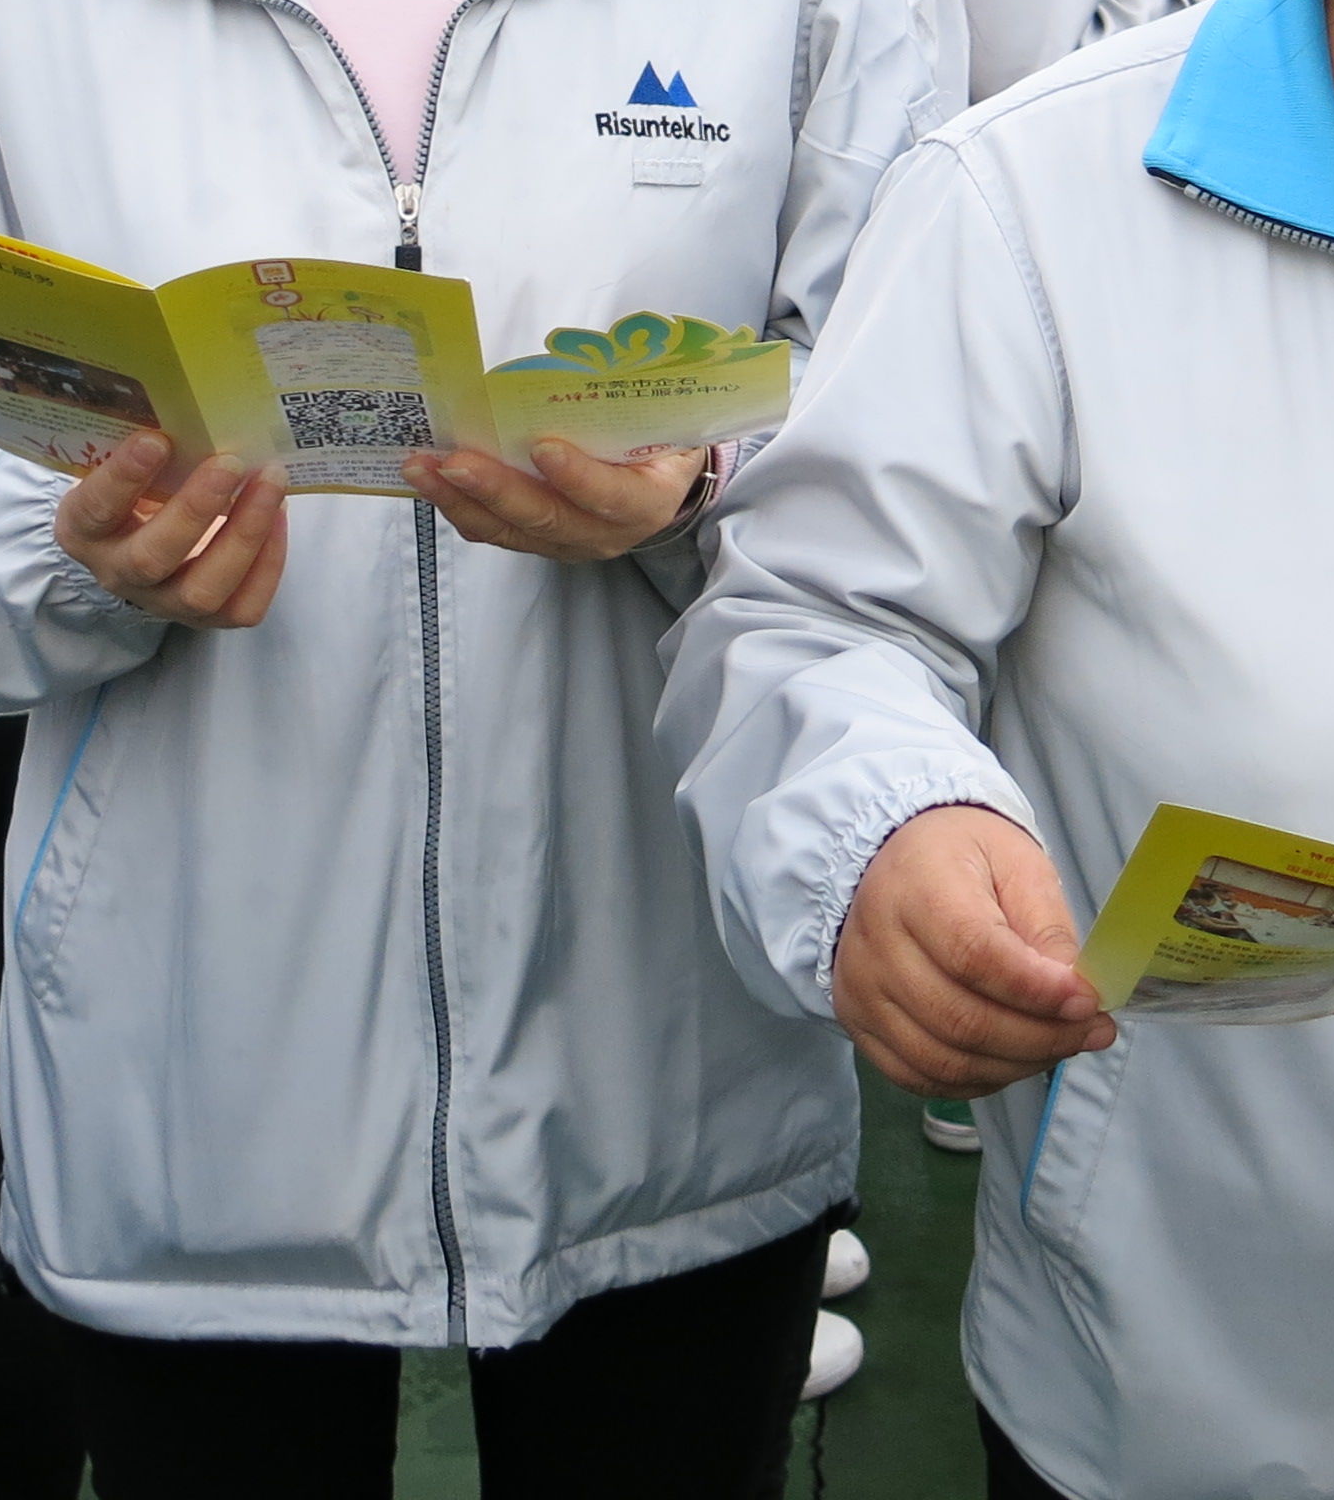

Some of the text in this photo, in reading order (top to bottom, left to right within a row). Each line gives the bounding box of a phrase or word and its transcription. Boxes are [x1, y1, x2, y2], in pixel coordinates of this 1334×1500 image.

[595, 111, 731, 142] Risuntek Inc
[584, 376, 698, 391] 东莞市企石
